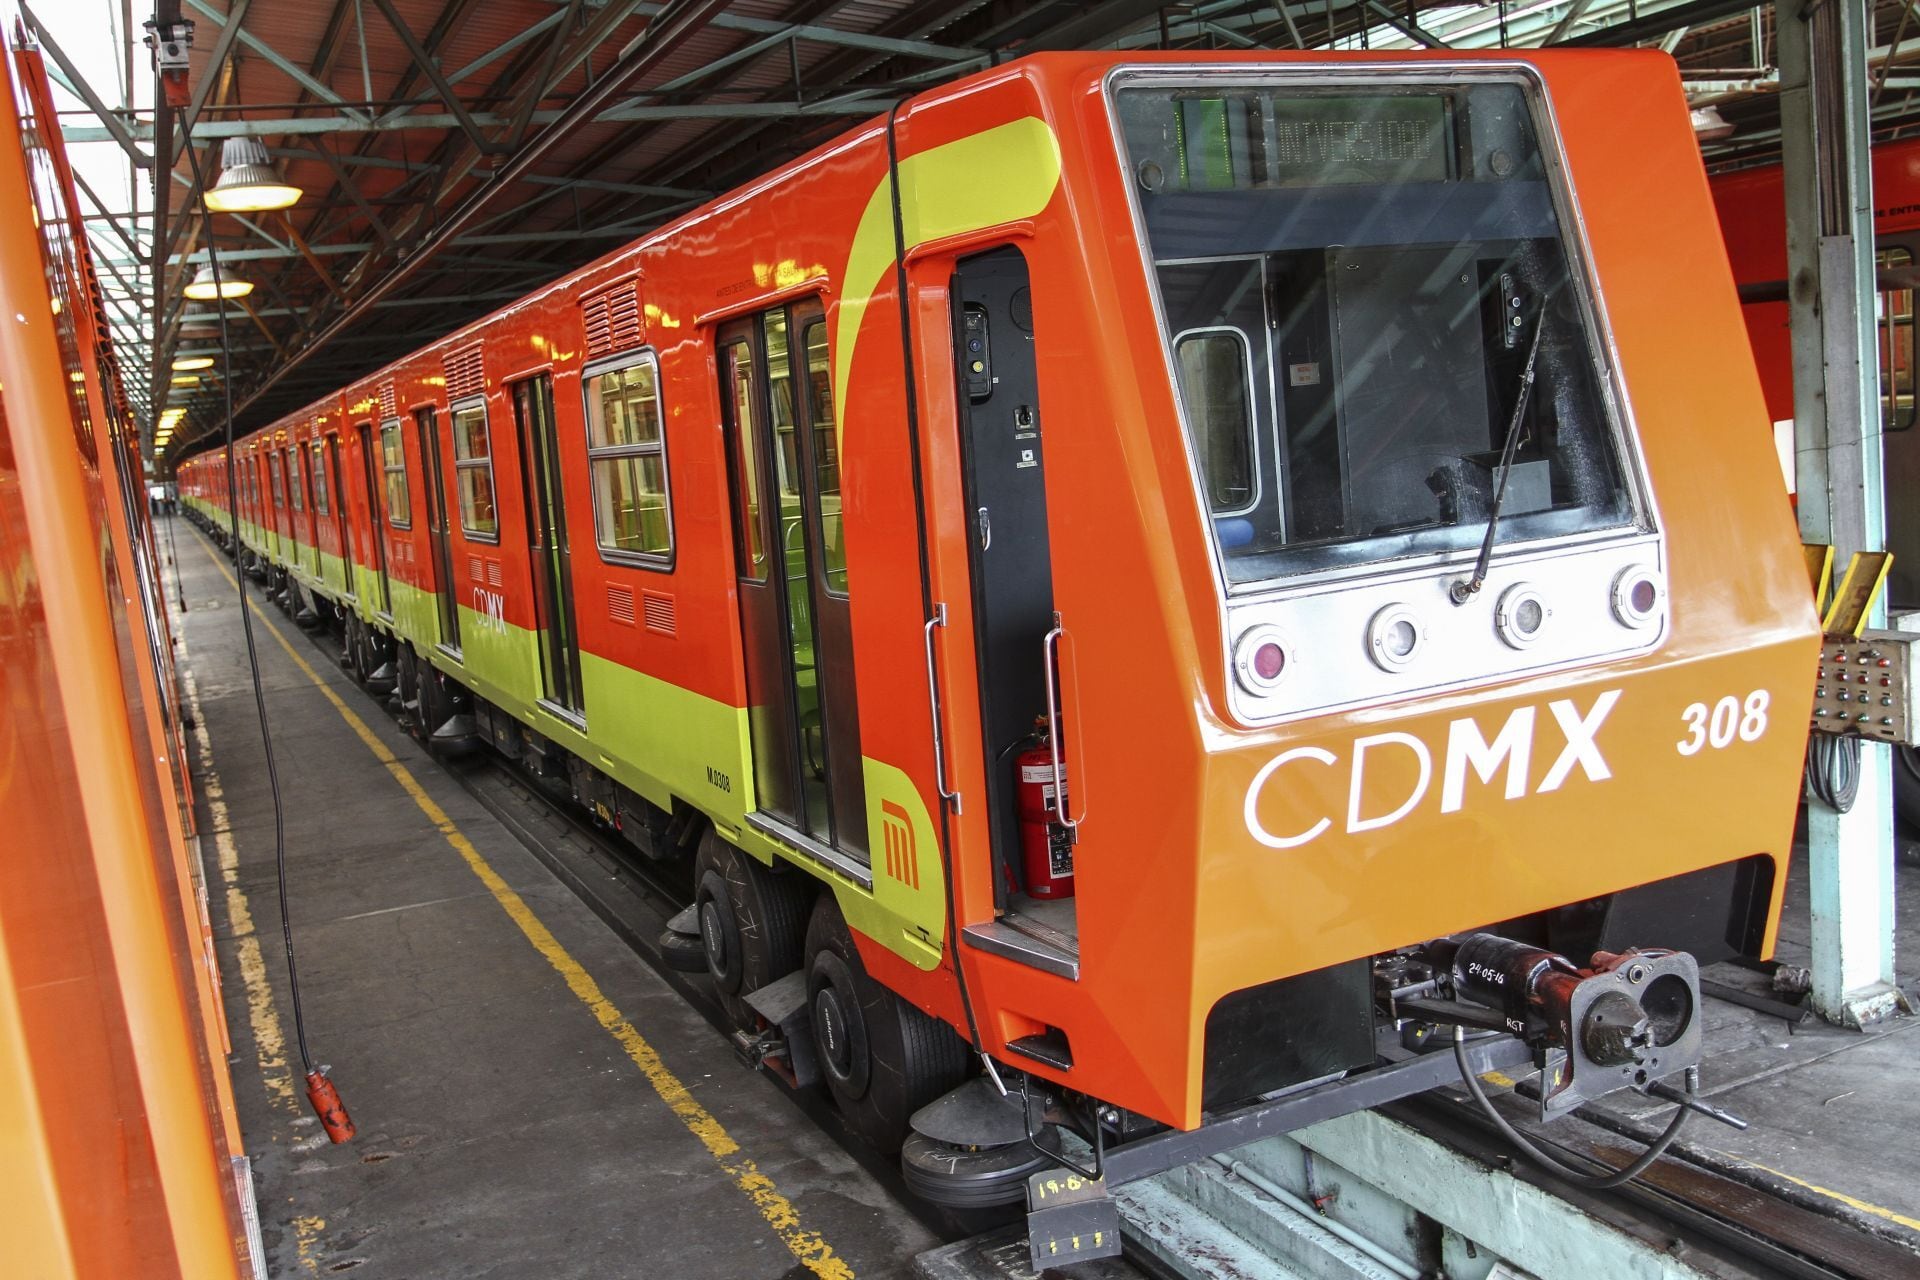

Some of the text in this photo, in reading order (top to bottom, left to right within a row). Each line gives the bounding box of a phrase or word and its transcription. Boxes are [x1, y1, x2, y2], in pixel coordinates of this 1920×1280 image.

[473, 586, 507, 636] CDMX
[1244, 689, 1771, 849] CDMX 308
